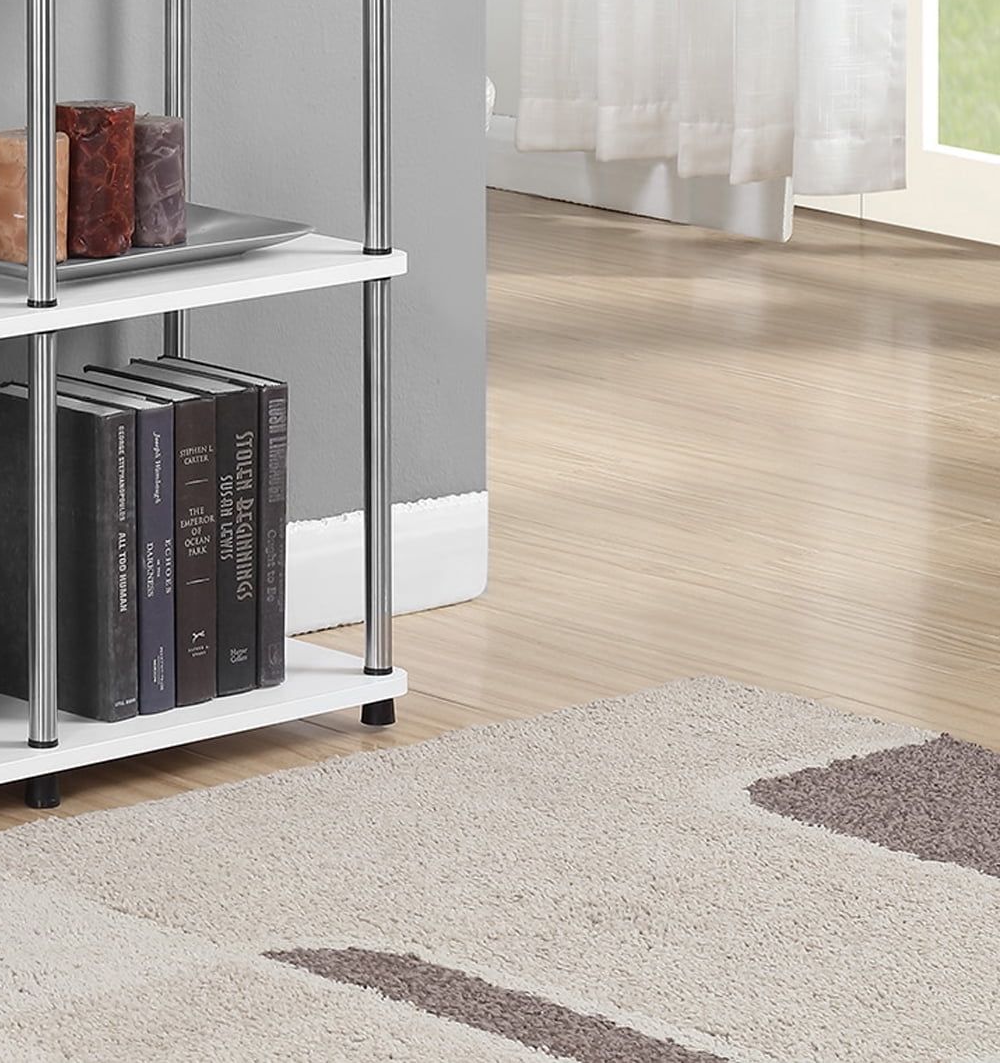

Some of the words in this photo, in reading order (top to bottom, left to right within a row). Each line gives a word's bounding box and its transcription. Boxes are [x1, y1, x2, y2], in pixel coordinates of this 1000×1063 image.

[180, 445, 208, 458] STEPHEN
[183, 454, 209, 466] CARTER
[235, 431, 254, 491] STOLEN
[220, 474, 234, 517] SUSAN
[188, 506, 205, 516] THE
[180, 515, 215, 529] EMPEROR
[191, 526, 202, 537] OF
[118, 532, 126, 550] ALL
[184, 535, 211, 548] OCEAN
[220, 522, 234, 561] LEWIS
[236, 497, 254, 601] BEGINNINGS
[188, 545, 208, 557] PARK
[118, 551, 127, 572] TOO
[146, 542, 154, 598] DARKNESS
[164, 539, 172, 593] ECHOES
[119, 574, 128, 613] HUMAN
